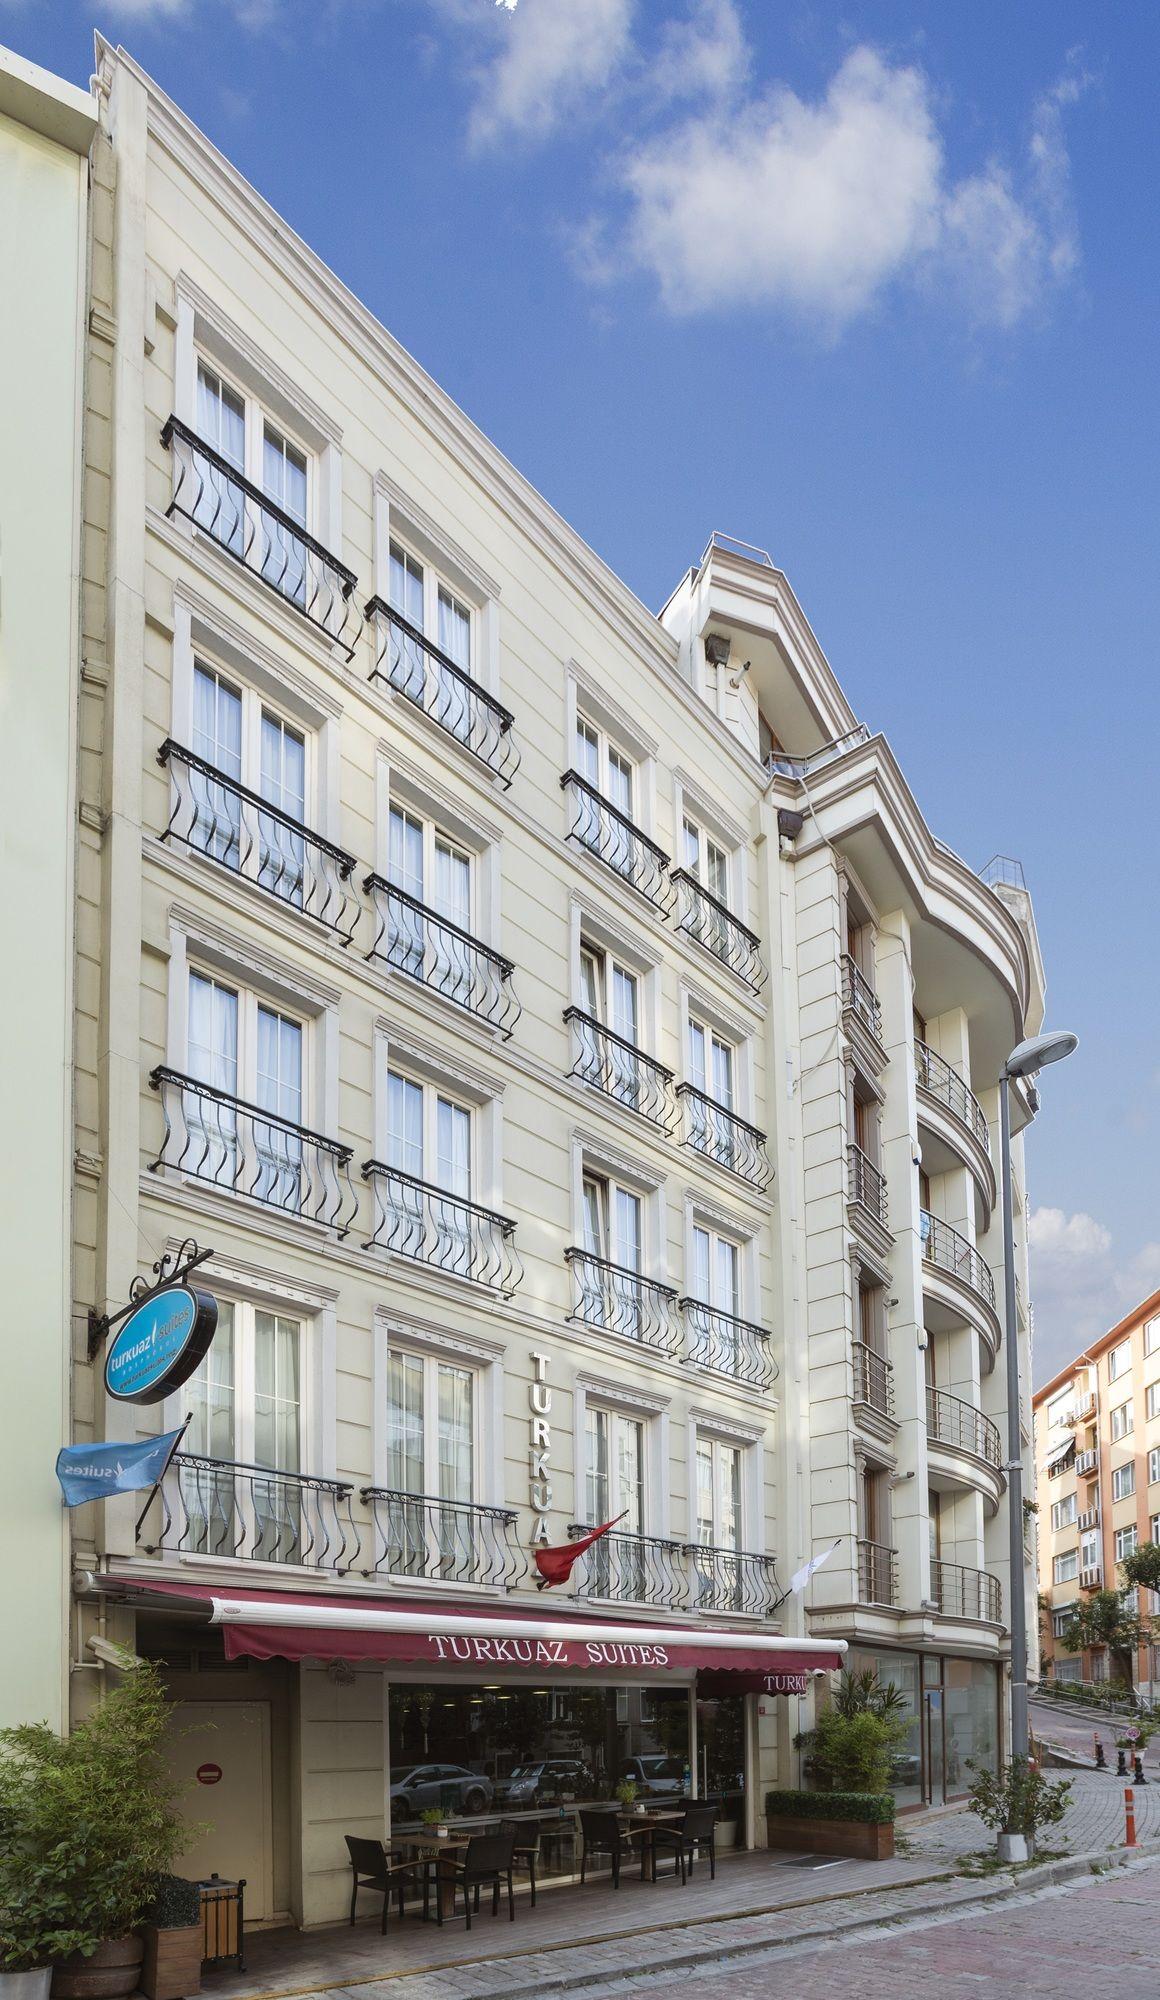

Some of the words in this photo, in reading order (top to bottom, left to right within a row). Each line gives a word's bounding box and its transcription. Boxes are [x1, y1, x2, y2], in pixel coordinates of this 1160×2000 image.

[111, 1336, 151, 1372] turkuaz
[159, 1305, 190, 1339] suites
[528, 1351, 553, 1577] TURKUA
[428, 1634, 568, 1662] TURKUAZ
[586, 1642, 669, 1665] SUITES
